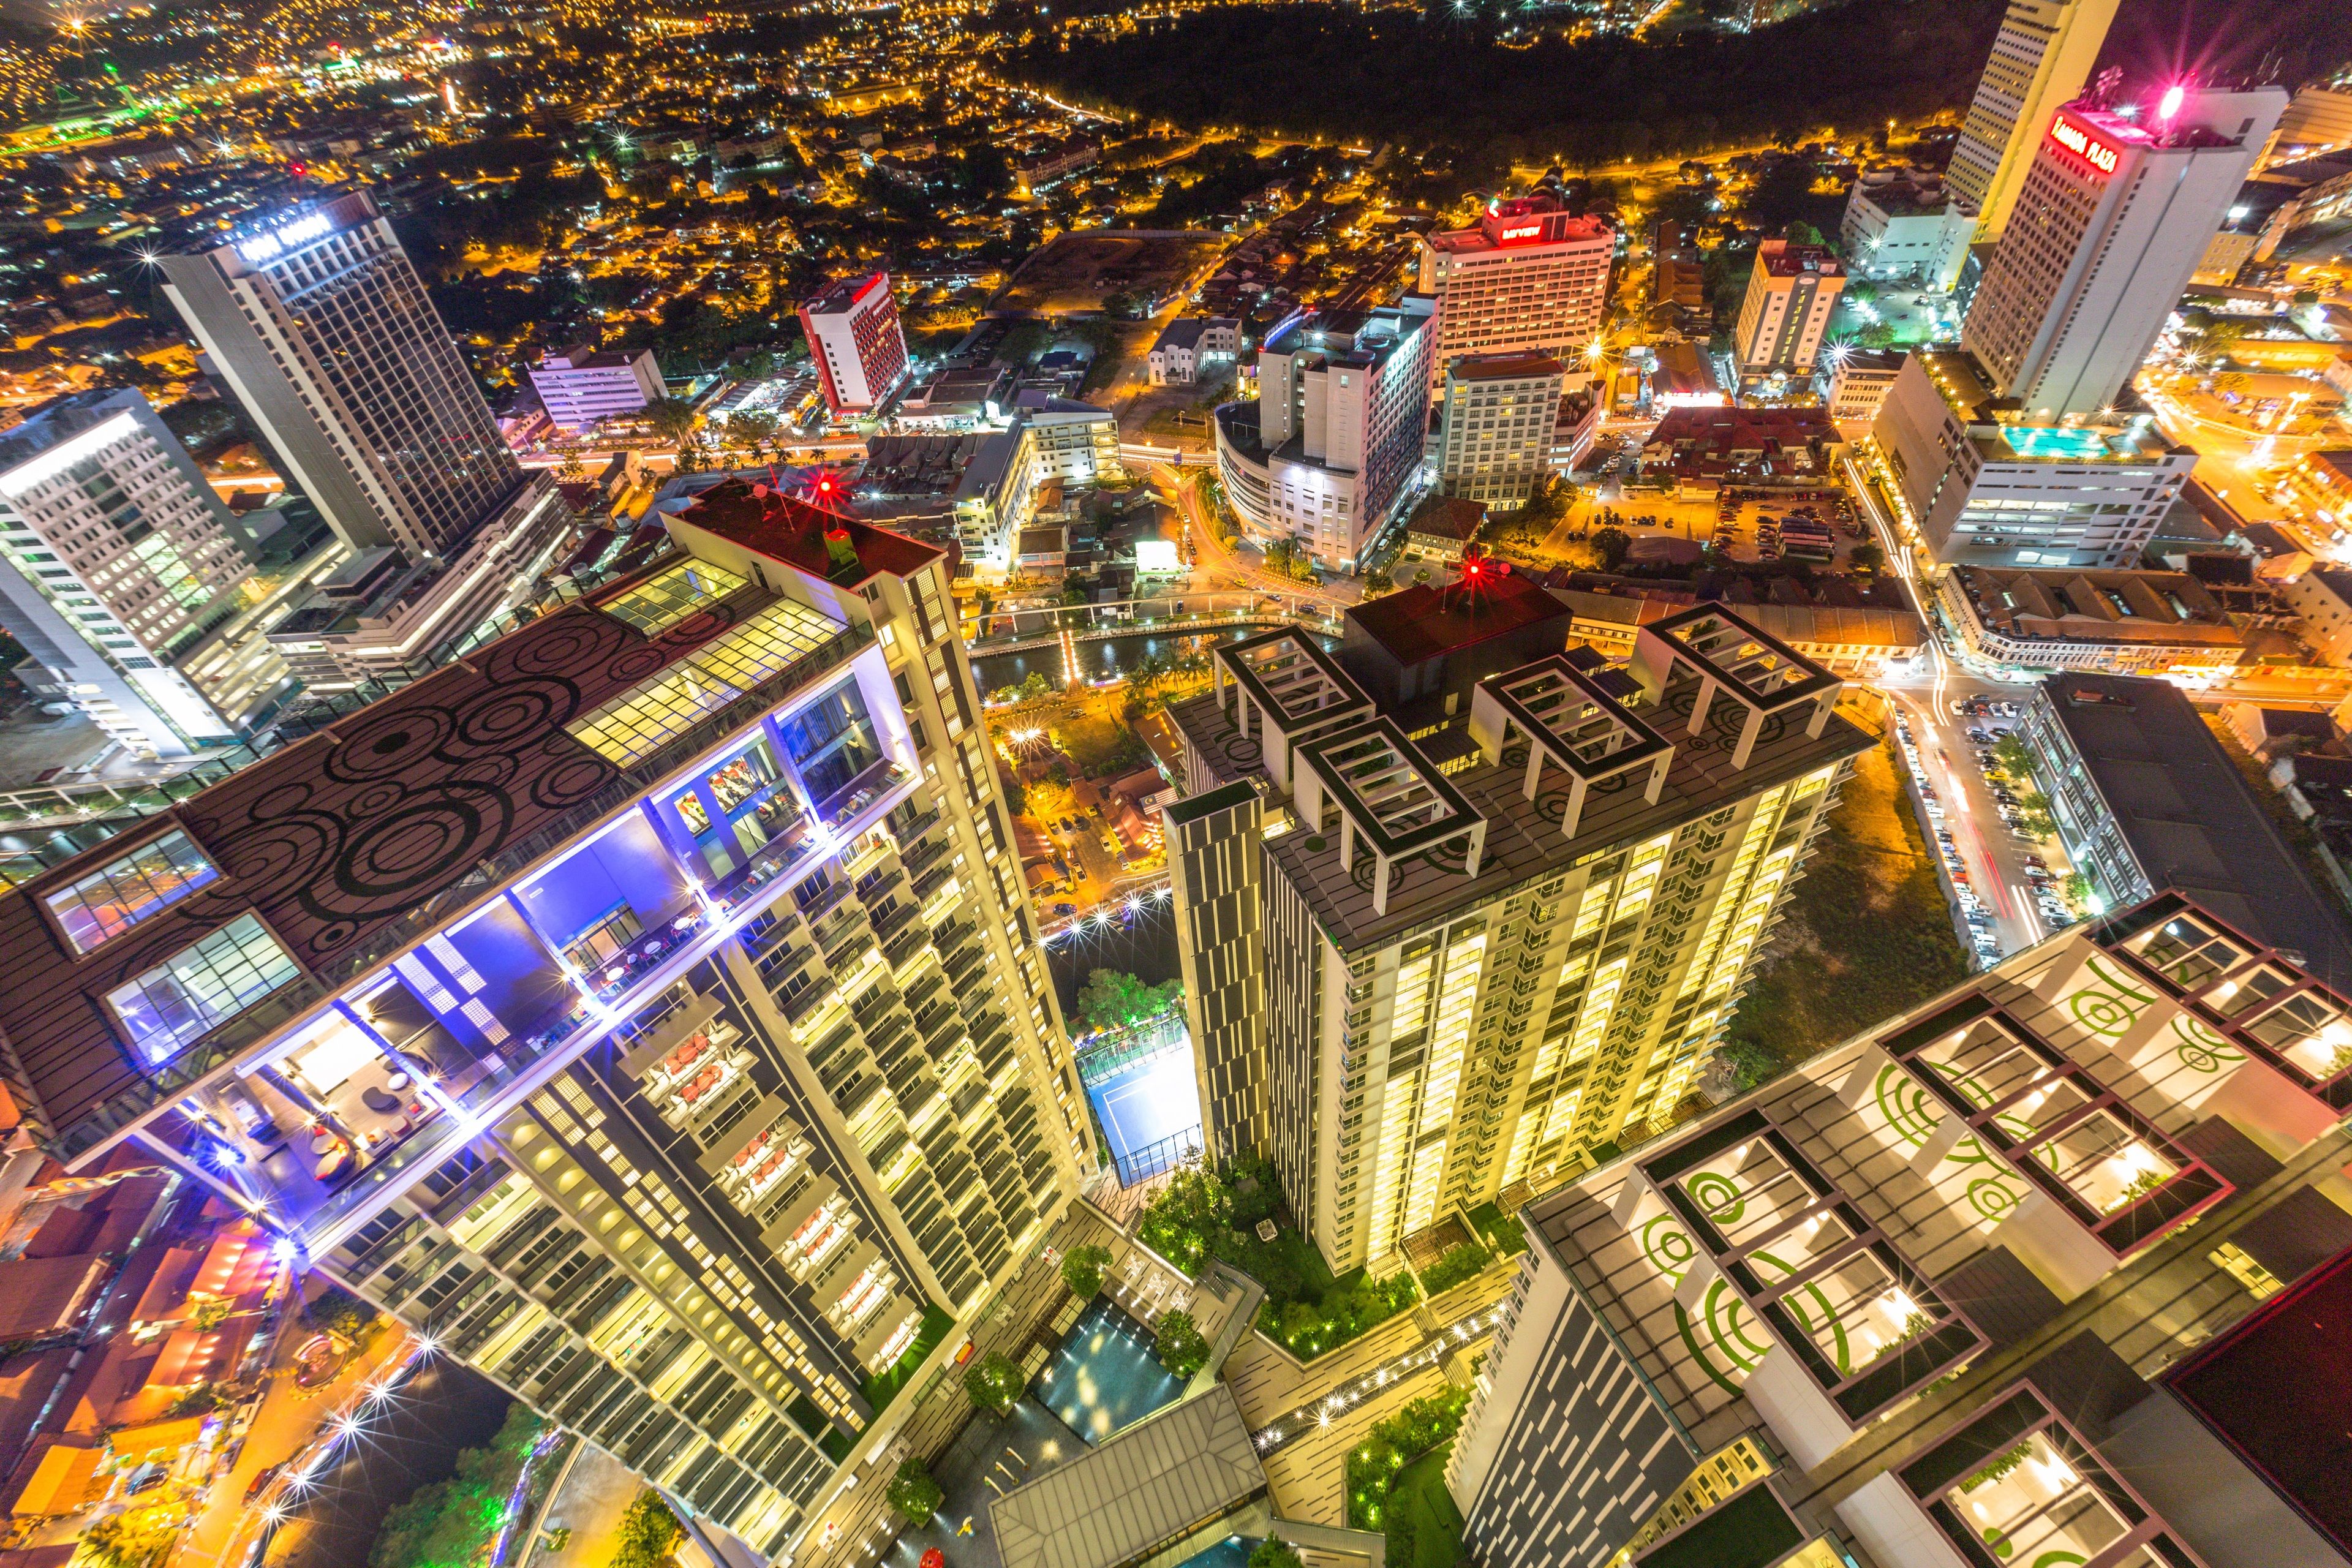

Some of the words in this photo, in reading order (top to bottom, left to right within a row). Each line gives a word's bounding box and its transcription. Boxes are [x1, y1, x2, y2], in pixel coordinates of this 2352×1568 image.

[2051, 116, 2088, 154] RAMADA
[2086, 142, 2117, 173] PLAZA
[1502, 225, 1540, 239] BAYVIEW
